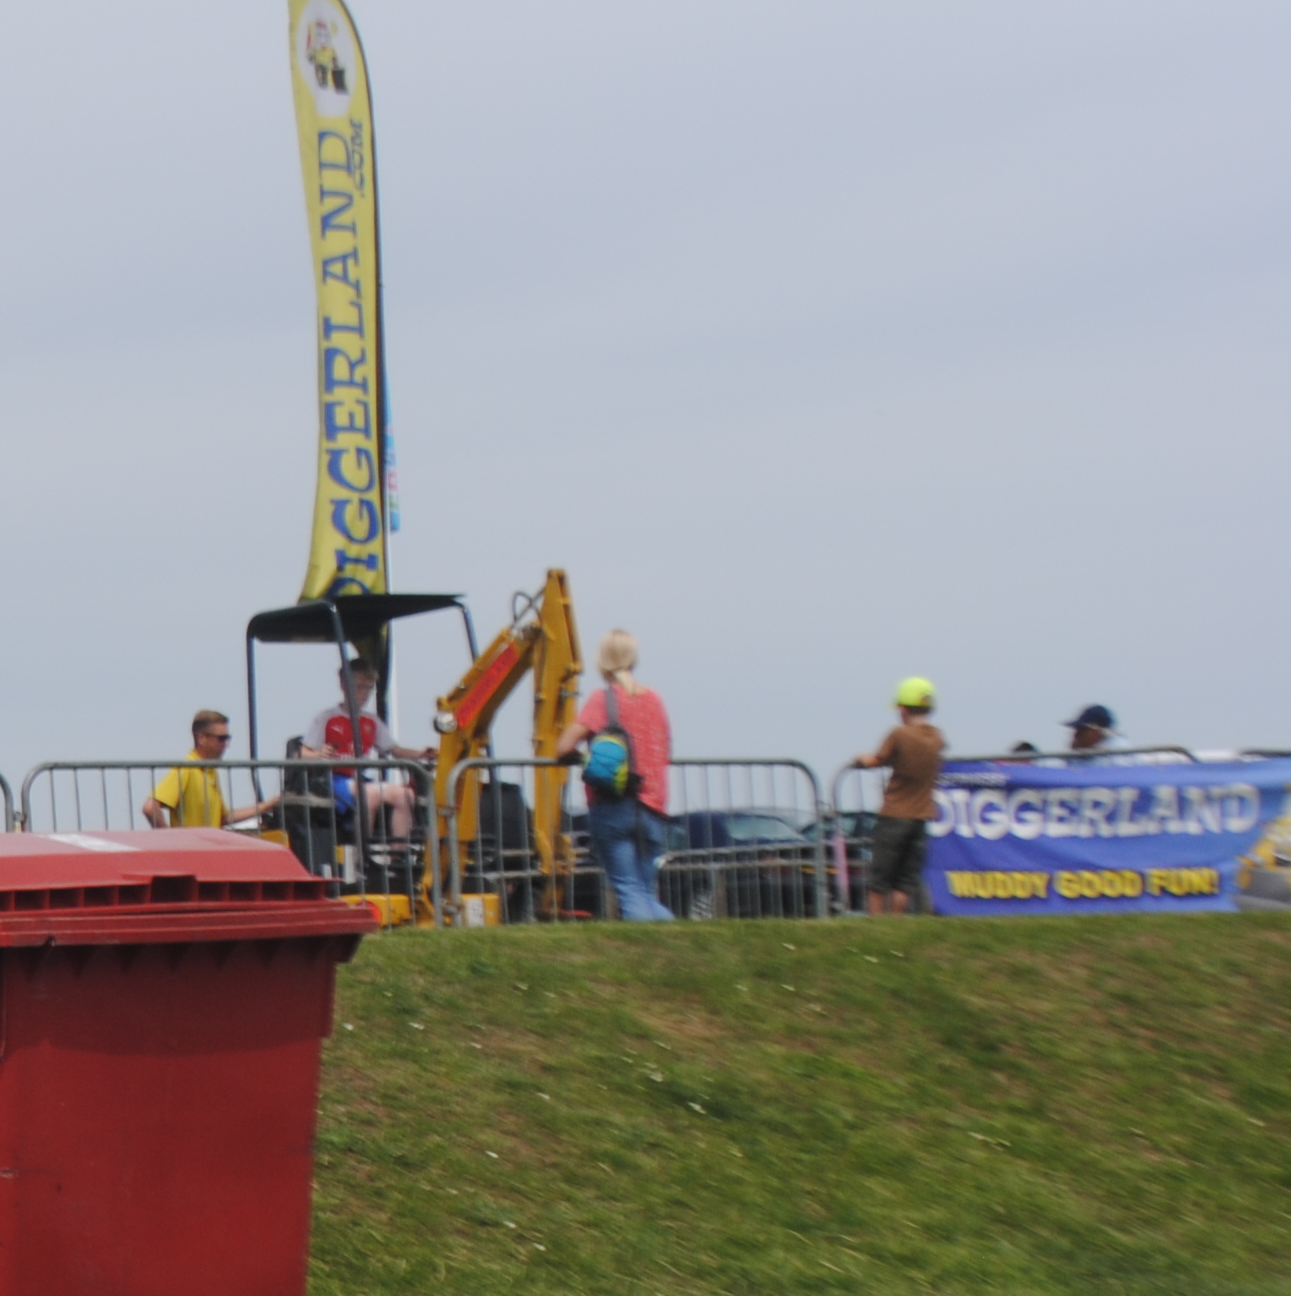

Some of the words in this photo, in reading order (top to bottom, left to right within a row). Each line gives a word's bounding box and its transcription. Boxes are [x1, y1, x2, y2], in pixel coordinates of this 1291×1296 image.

[947, 871, 1049, 898] MUDDY
[1054, 868, 1144, 899] GOOD
[1147, 866, 1220, 897] FUN!
